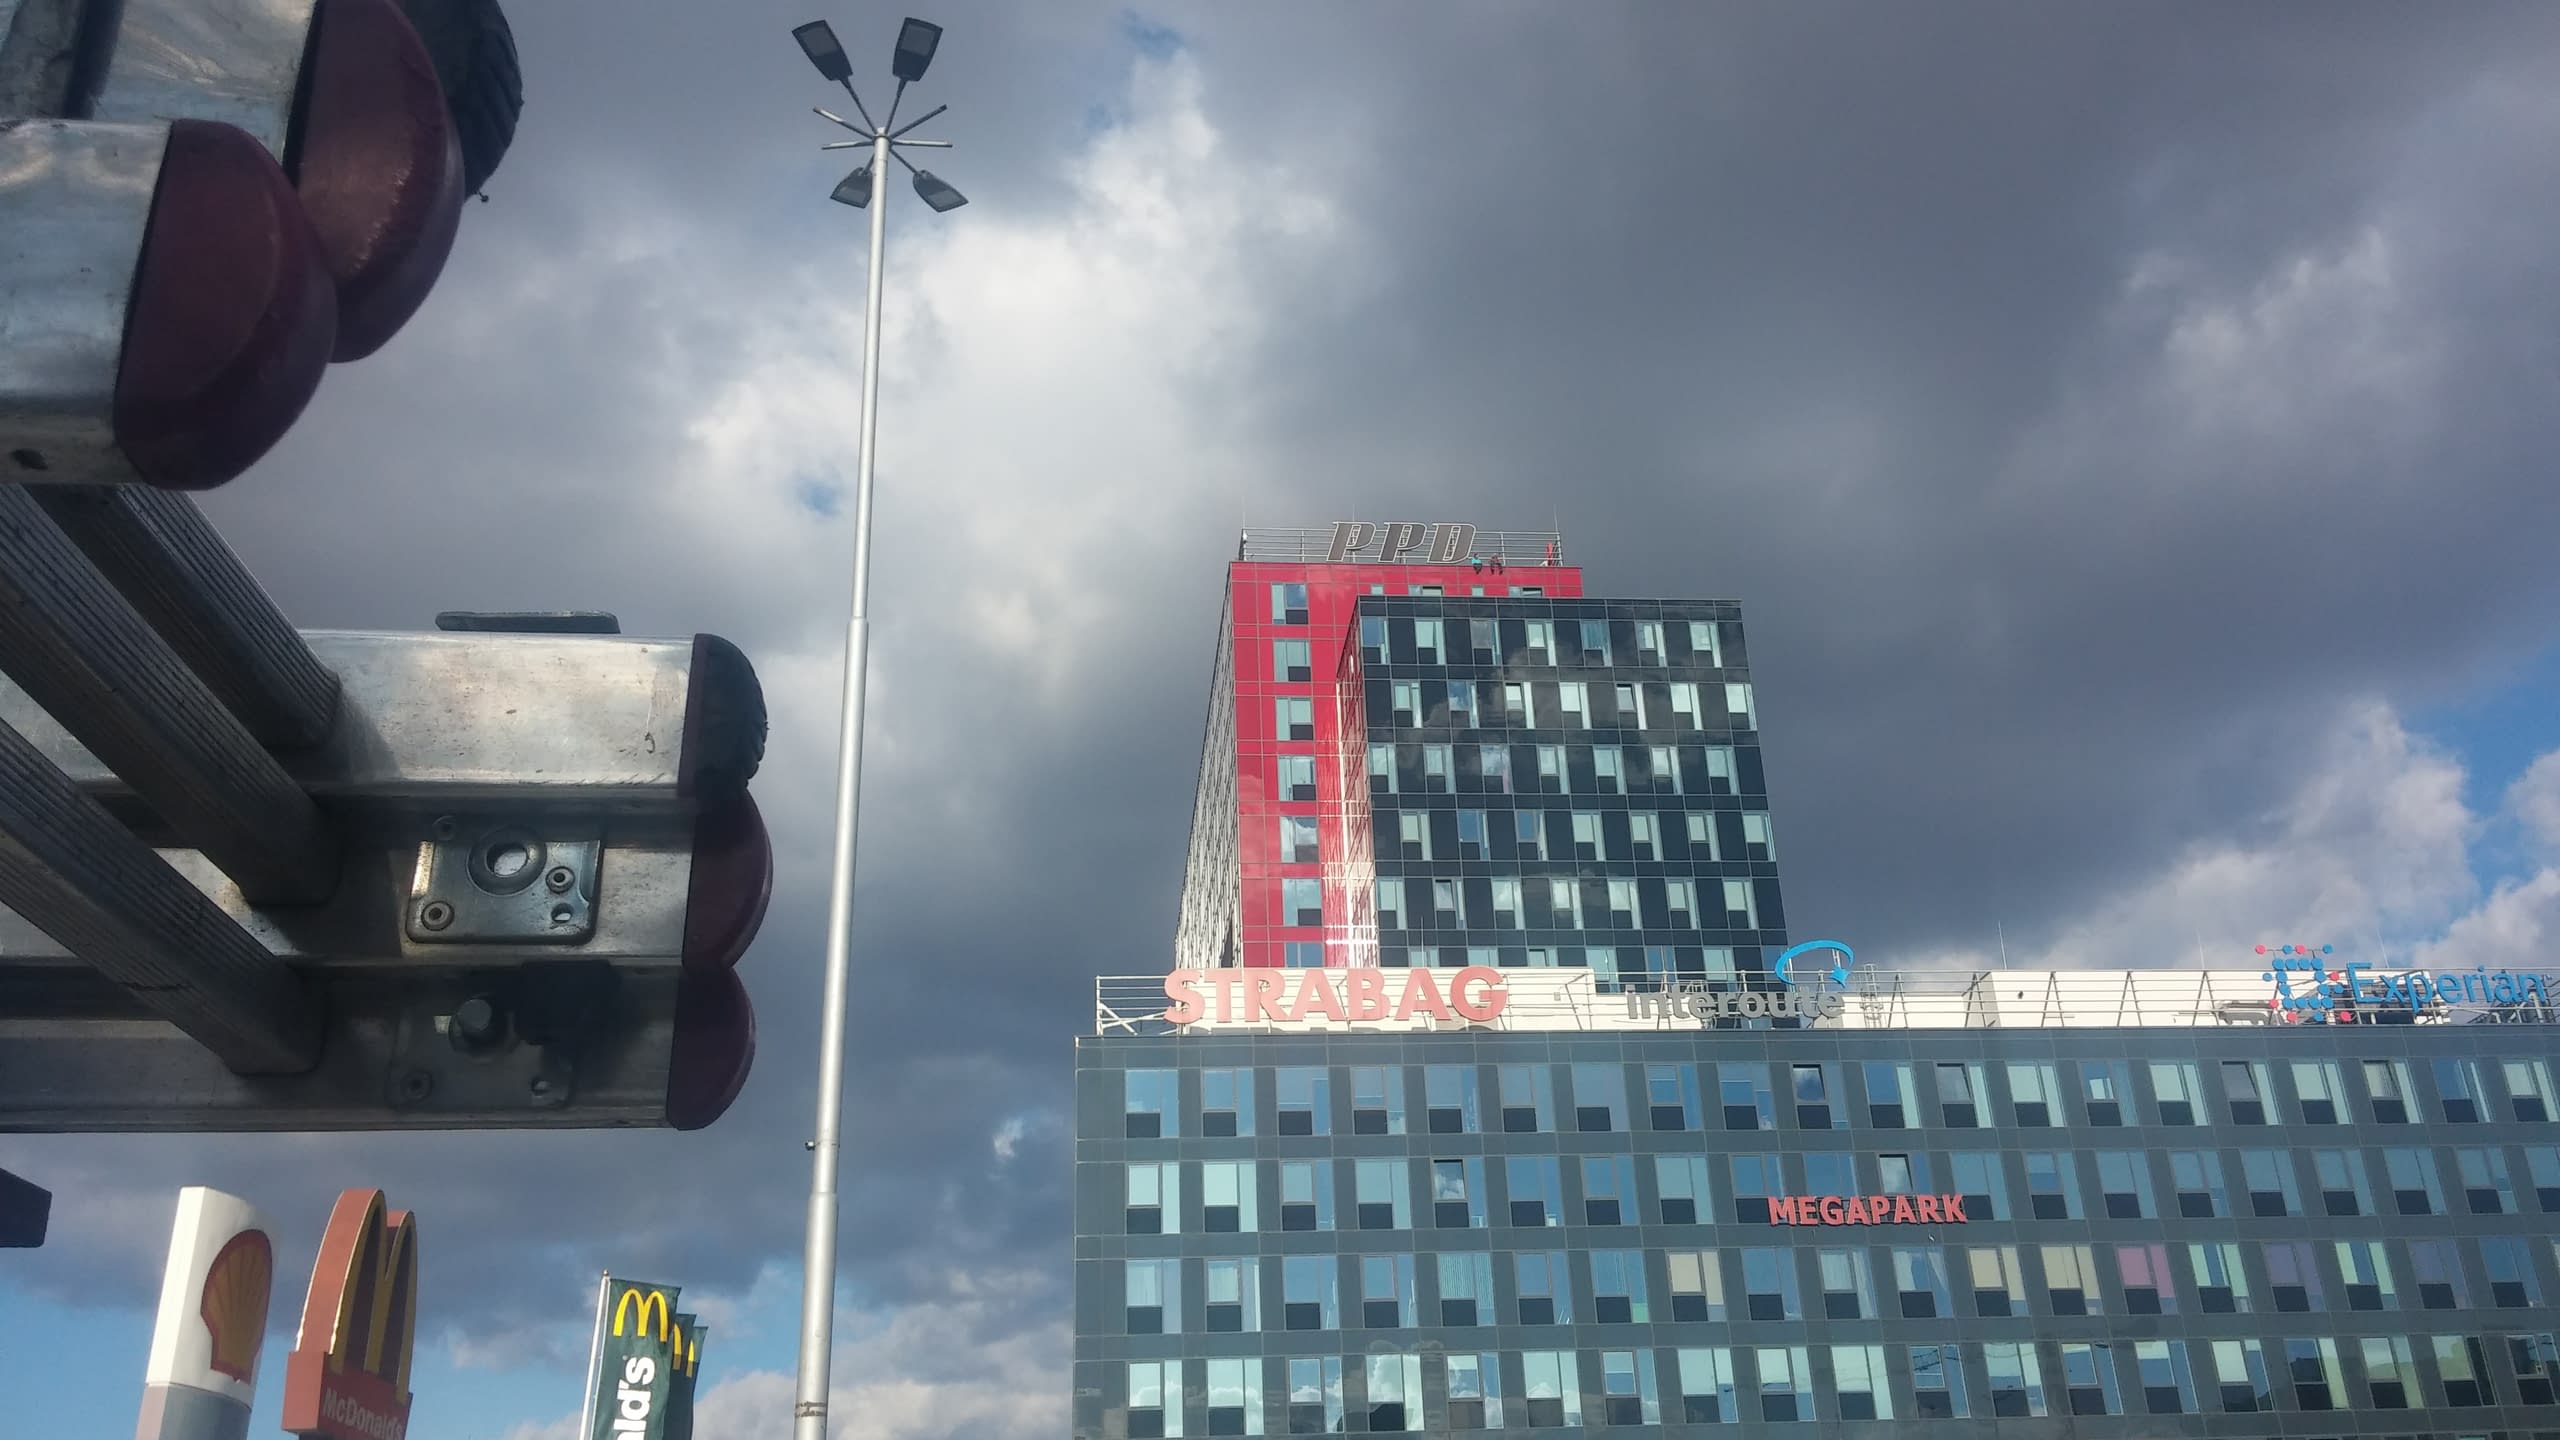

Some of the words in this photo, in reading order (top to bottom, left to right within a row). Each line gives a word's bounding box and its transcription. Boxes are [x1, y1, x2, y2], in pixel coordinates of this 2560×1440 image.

[1326, 521, 1477, 564] PPD
[1163, 966, 1508, 1025] STRABAG
[1625, 984, 1845, 1020] interoute
[2346, 961, 2546, 1015] Experian
[1767, 1193, 1968, 1226] MEGAPARK
